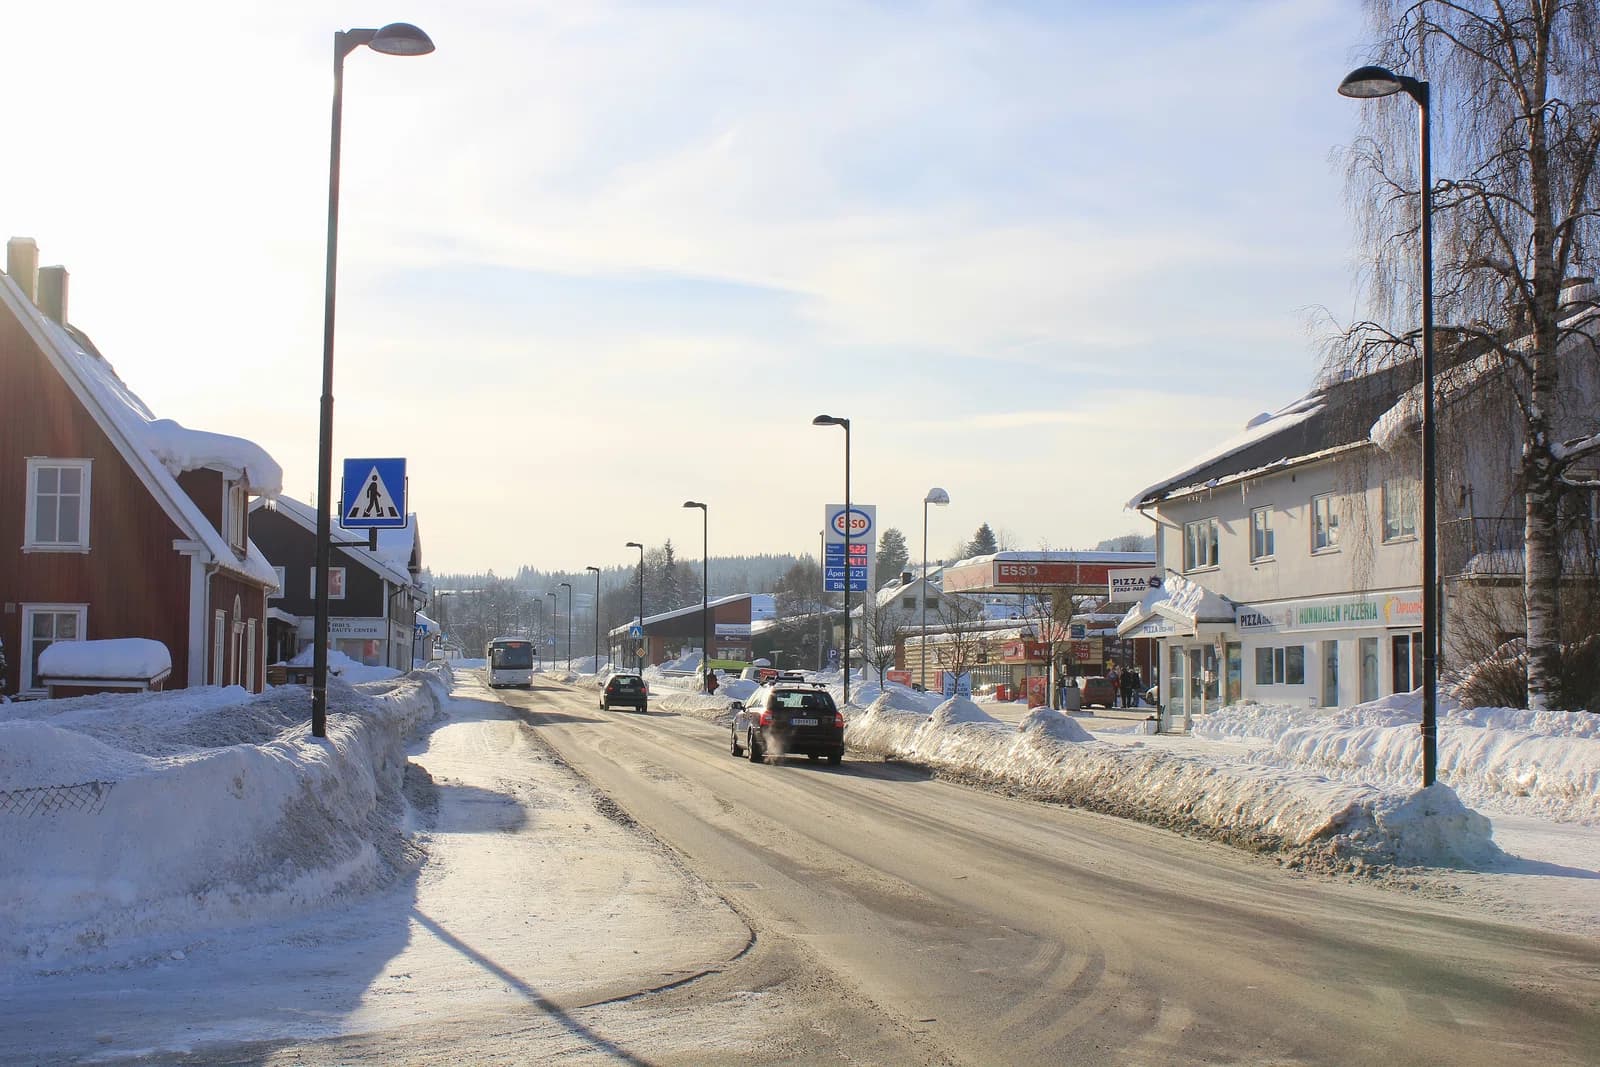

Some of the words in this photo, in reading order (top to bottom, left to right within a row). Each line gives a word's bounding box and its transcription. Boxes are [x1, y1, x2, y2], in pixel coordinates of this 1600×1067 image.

[837, 516, 866, 529] Eso
[1001, 565, 1038, 576] ESSO
[1113, 577, 1145, 586] PIZZA
[1343, 602, 1378, 621] PIZZERIA
[1240, 613, 1263, 627] PIZZA
[830, 650, 837, 658] P
